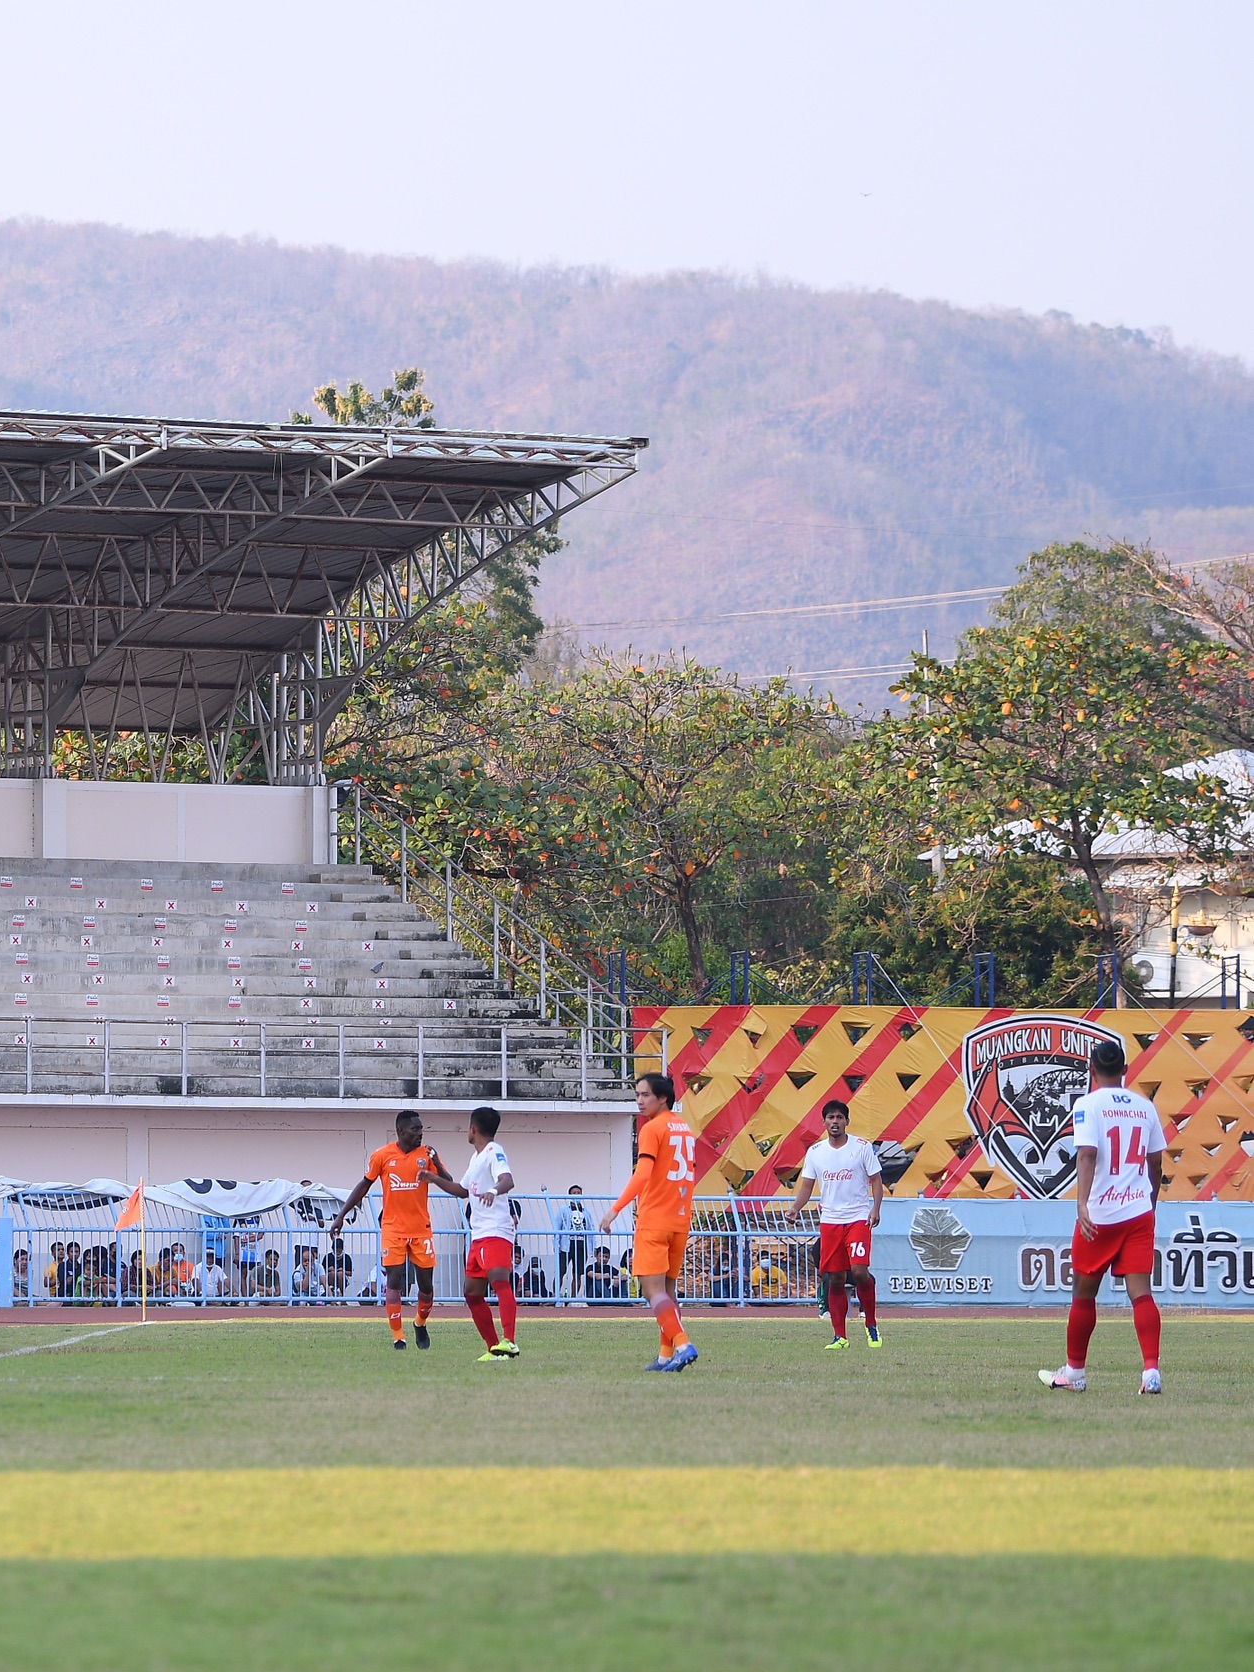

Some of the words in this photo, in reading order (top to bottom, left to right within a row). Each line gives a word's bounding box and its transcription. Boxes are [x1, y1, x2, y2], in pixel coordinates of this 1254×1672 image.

[975, 1028, 1051, 1066] MUANGKAN
[1061, 1029, 1103, 1059] UNIT
[975, 1056, 1059, 1078] FOOTBALL
[1111, 1094, 1132, 1104] BG
[1102, 1109, 1148, 1120] RONNACHAI
[666, 1135, 695, 1182] 35
[1106, 1125, 1146, 1176] 14
[1099, 1184, 1145, 1206] AirAsia
[849, 1241, 866, 1258] 16
[889, 1277, 993, 1292] TEEWISET
